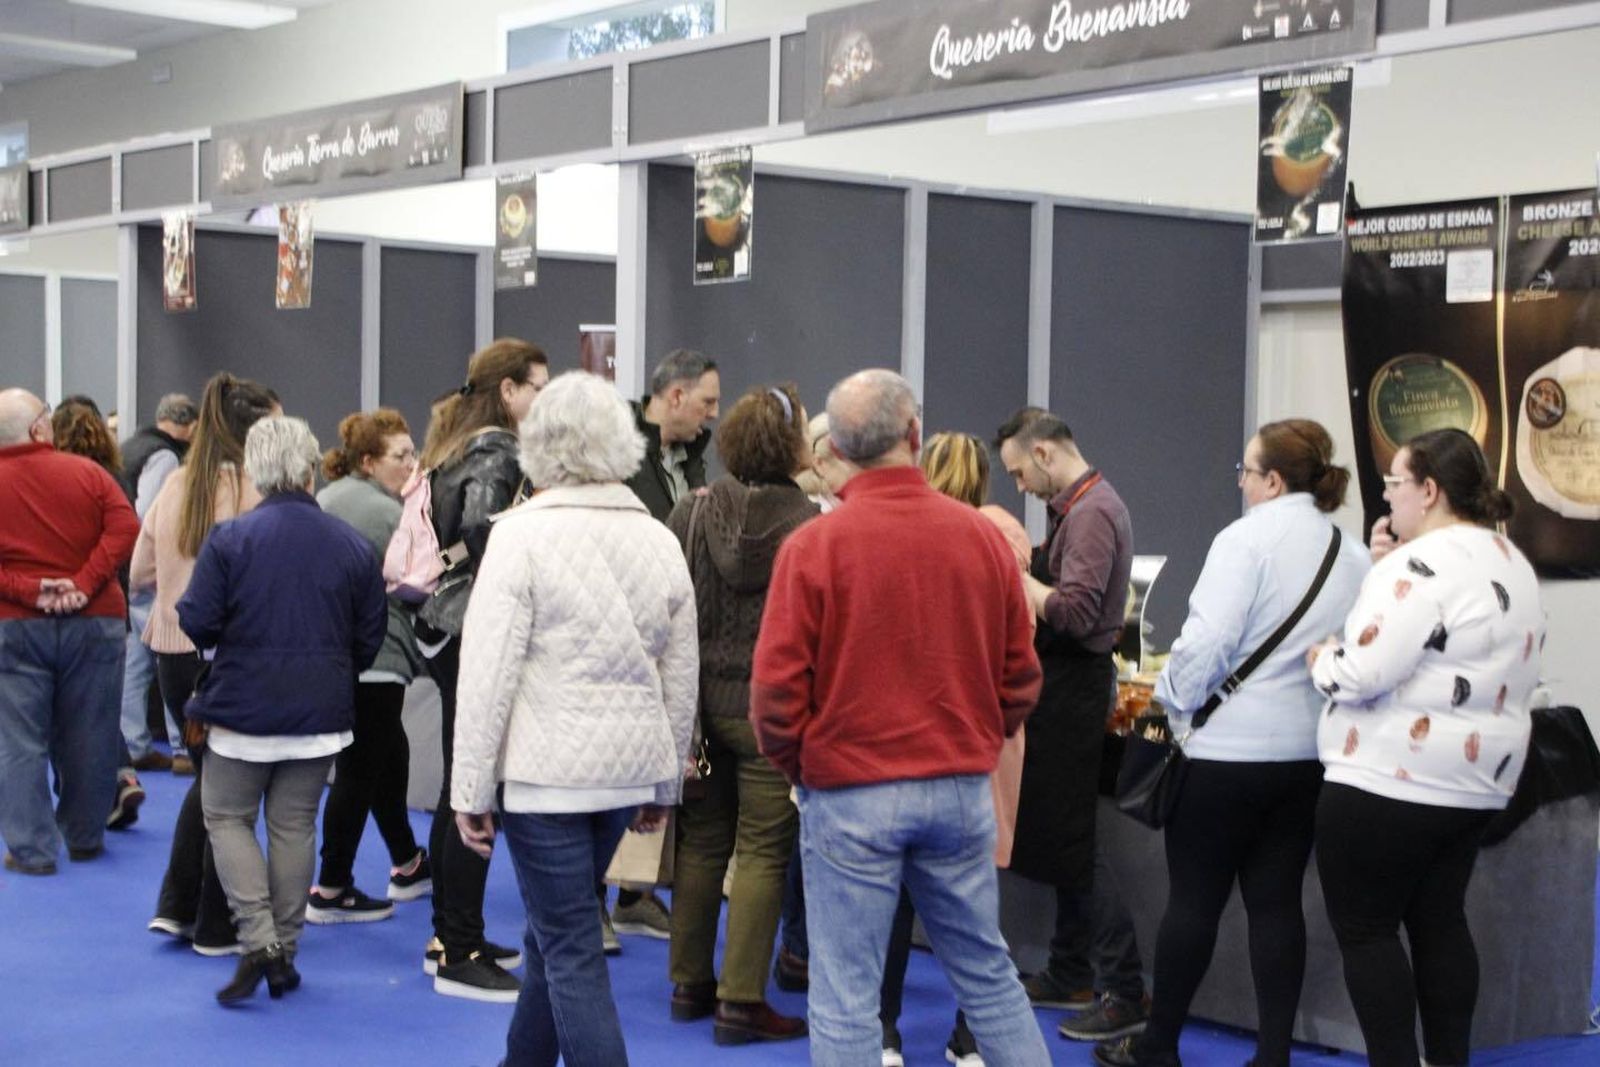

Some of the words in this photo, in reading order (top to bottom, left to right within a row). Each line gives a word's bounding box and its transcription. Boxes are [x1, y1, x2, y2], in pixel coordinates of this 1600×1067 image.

[1043, 0, 1191, 52] Buenavista
[342, 124, 355, 156] de
[358, 121, 400, 157] Barros
[1388, 213, 1426, 232] QUESO
[1429, 212, 1445, 229] DE
[1447, 206, 1493, 228] ESPAÑA
[1522, 200, 1593, 222] BRONZE
[1351, 235, 1389, 253] WORLD
[1392, 231, 1436, 251] CHEESE
[1439, 228, 1488, 247] AWARDS
[1517, 220, 1585, 240] CHEESE
[1390, 250, 1445, 269] 2022/2023
